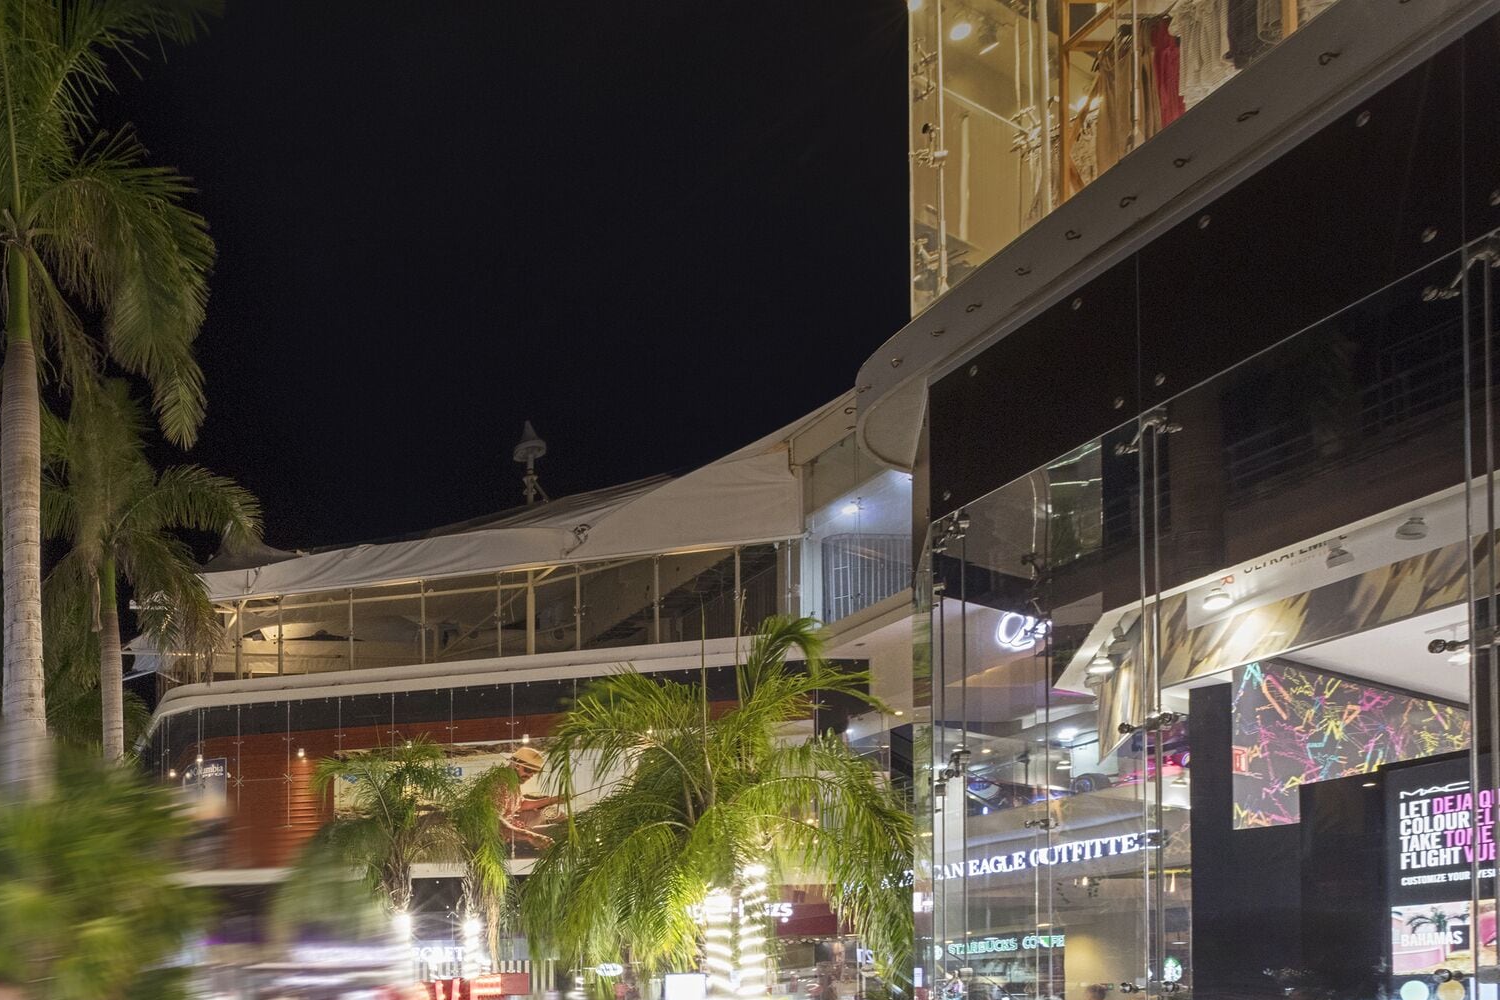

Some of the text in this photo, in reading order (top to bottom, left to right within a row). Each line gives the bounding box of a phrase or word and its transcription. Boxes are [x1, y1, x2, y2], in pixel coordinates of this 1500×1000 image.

[1400, 781, 1470, 799] MAC
[1399, 799, 1430, 820] LET
[1432, 793, 1473, 815] DEJA
[1399, 811, 1471, 836] COLOUR
[969, 851, 1026, 877] EAGLE
[1030, 829, 1161, 867] OUTFITTE
[1399, 832, 1442, 853] TAKE
[1400, 842, 1496, 870] FLIGHT VUE
[1401, 873, 1446, 886] CUSTOMIZE
[1447, 870, 1471, 881] YOUR
[947, 938, 1018, 955] STARBUCKS
[1402, 930, 1463, 947] BAHAMAS
